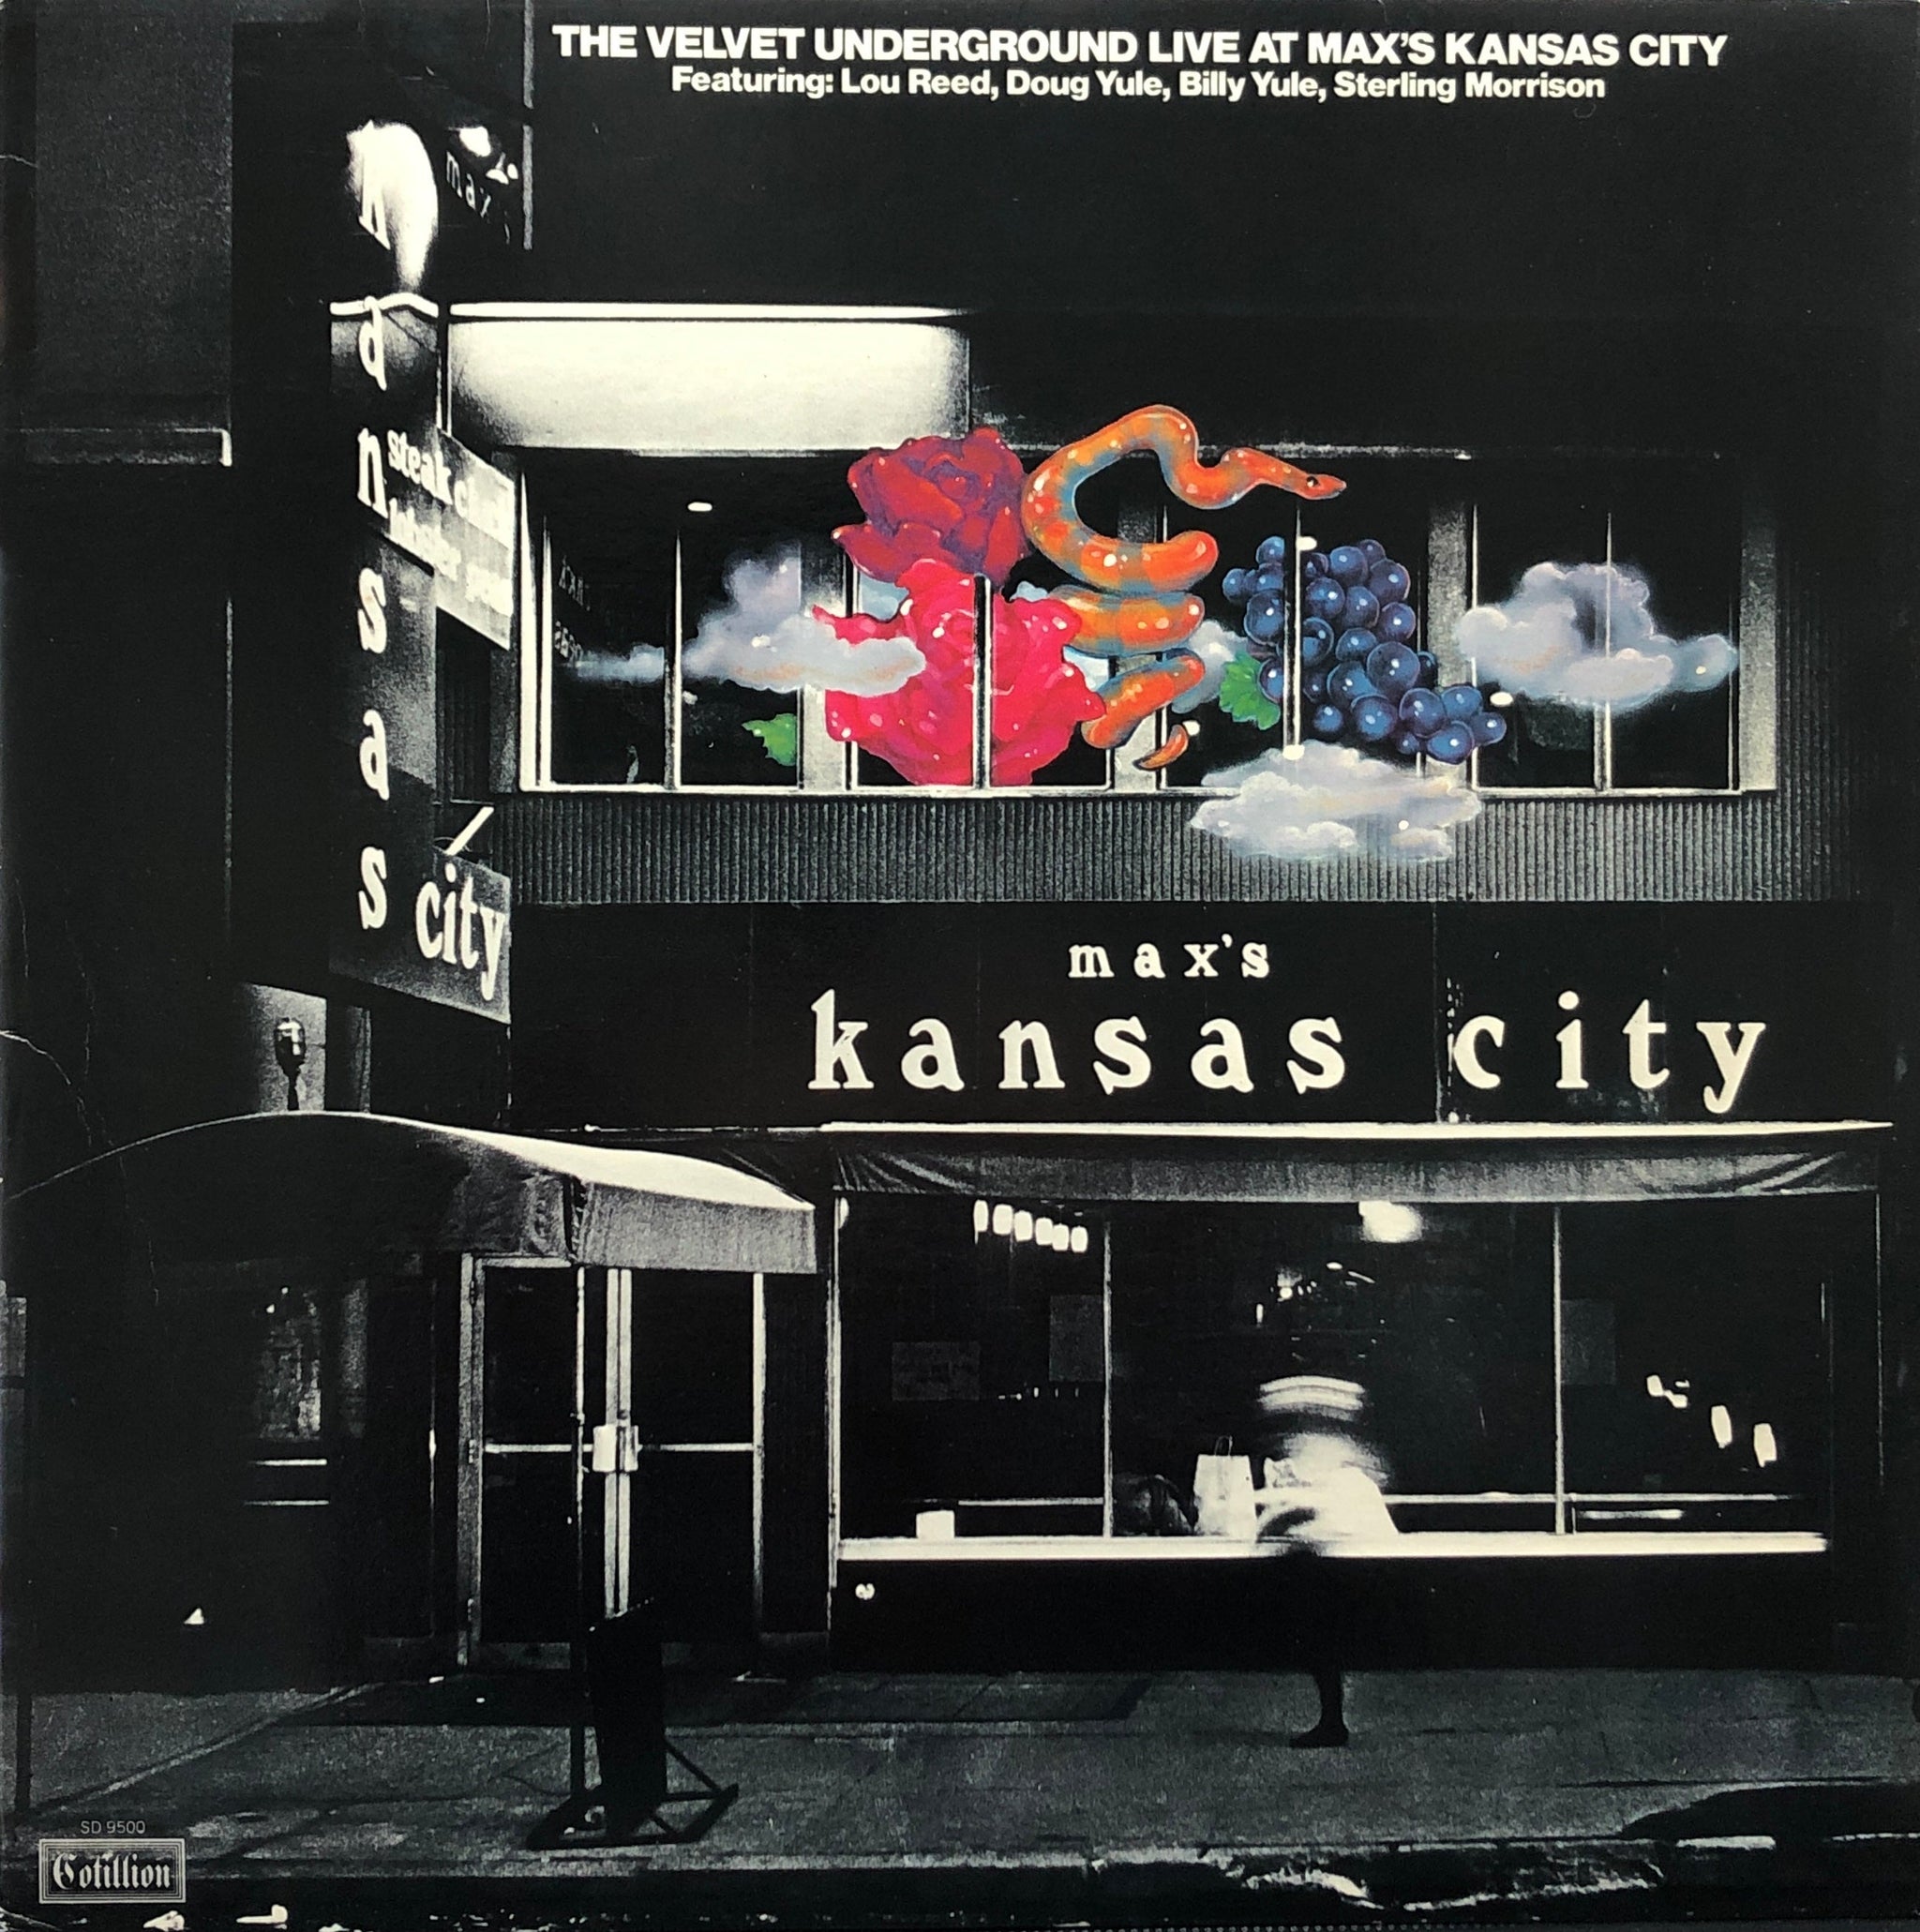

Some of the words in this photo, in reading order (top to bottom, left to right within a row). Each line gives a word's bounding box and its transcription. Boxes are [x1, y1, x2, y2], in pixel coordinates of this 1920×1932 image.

[386, 429, 455, 506] steak
[415, 863, 507, 1001] city
[1068, 933, 1270, 979] max's
[807, 988, 1346, 1095] kansas
[1453, 990, 1767, 1114] city
